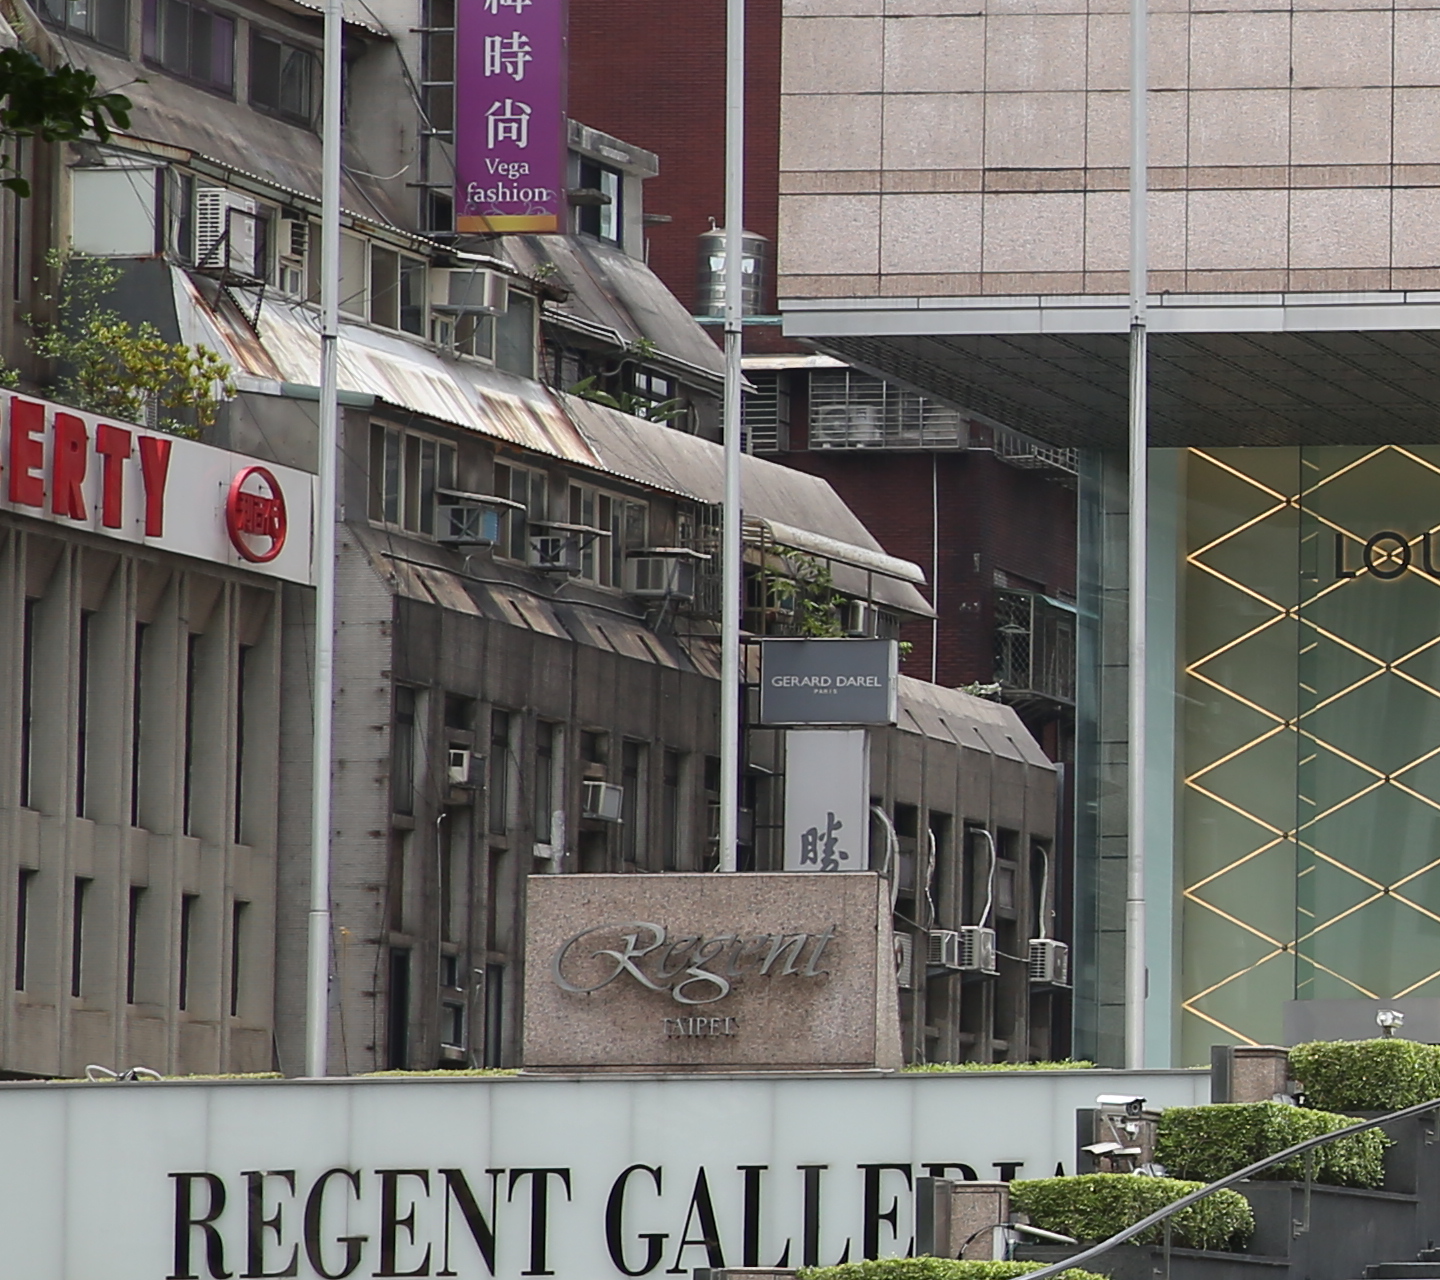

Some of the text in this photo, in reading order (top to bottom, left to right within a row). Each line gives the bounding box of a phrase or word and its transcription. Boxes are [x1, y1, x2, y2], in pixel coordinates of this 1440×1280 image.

[485, 157, 530, 180] Vega
[466, 182, 549, 203] fashion
[8, 395, 173, 539] ERTY
[771, 675, 882, 688] GERARD DAREL
[552, 920, 838, 1005] Regent
[662, 1017, 732, 1037] TAIPEI
[166, 1161, 1070, 1280] REGENT GALLE
